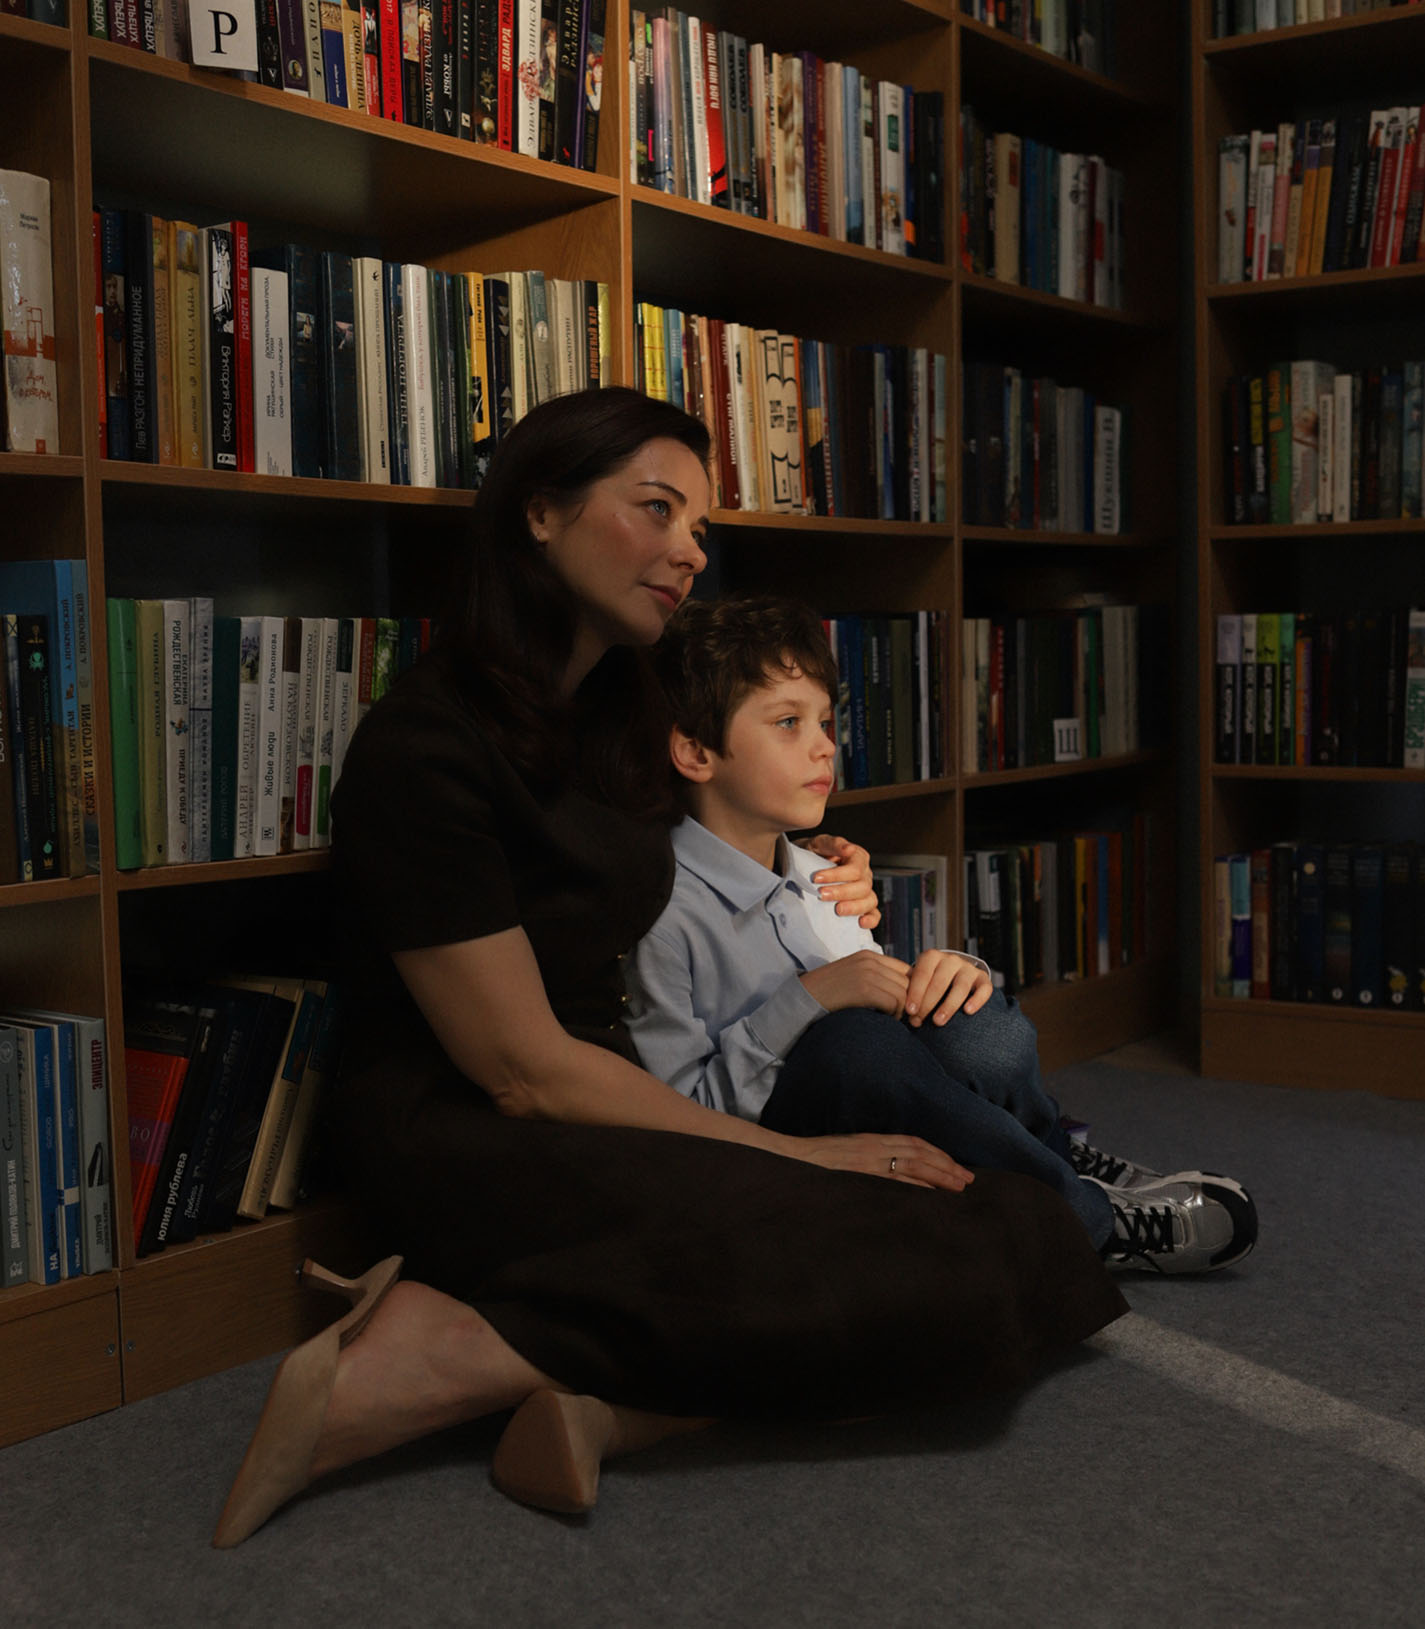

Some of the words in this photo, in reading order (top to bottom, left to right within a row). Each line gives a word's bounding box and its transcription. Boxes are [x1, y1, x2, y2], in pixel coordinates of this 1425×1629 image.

[93, 0, 106, 32] ЬЕЦУХ
[127, 4, 139, 43] ПЬЕЦУХ
[143, 11, 155, 50] ПЬЕЦУХ
[209, 10, 238, 54] Р
[352, 20, 363, 55] ДОЧЬ
[501, 27, 511, 72] ЭДВАРД
[705, 32, 719, 63] ЛЮДИ
[355, 57, 366, 109] ЛЕНИНА
[443, 64, 451, 96] КОБЫ
[707, 64, 719, 83] КАК
[727, 43, 737, 109] СОБОЛЕВ
[422, 71, 433, 120] ЭДВАРД
[709, 84, 721, 110] БОГИ
[238, 235, 248, 270] КРОВИ
[239, 276, 249, 291] НА
[239, 297, 249, 340] МОДЕРН
[588, 305, 599, 326] ЖАР
[131, 285, 147, 386] НЕПРИДУМАННОЕ
[396, 311, 407, 385] ПОРТРЕТА
[219, 345, 233, 400] Виктория
[133, 390, 145, 429] РАЗГОН
[400, 386, 408, 425] ТЕНЬ
[136, 431, 147, 449] Лев
[62, 599, 72, 661] ПОКРОВСКИЙ
[76, 593, 87, 654] ПОКРОВСКИЙ
[172, 620, 183, 705] РОЖДЕСТВЕНСКАЯ
[268, 633, 278, 685] Родионова
[304, 633, 313, 721] РОЖДЕСТВЕНСКАЯ
[323, 635, 333, 722] РОЖДЕСТВЕНСКАЯ
[268, 686, 276, 712] Анна
[341, 681, 349, 733] ЗЕРКАЛО
[82, 703, 93, 759] ИСТОРИИ
[242, 701, 251, 771] ОБРЕТЕНИЕ
[266, 731, 276, 758] люди
[84, 759, 93, 768] И
[178, 749, 187, 786] ПРИЕДУ
[264, 760, 275, 797] Живые
[85, 770, 96, 816] СКАЗКИ
[179, 795, 187, 825] ОБЕДУ
[238, 784, 249, 839] АНДРЕЙ
[91, 1039, 104, 1090] ЭПИЦЕНТР
[157, 1206, 174, 1241] юлия
[166, 1152, 189, 1206] рублева
[9, 1216, 21, 1249] ДМИТРИЙ
[95, 1213, 104, 1246] ДМИТРИЙ
[49, 1253, 58, 1272] НА
